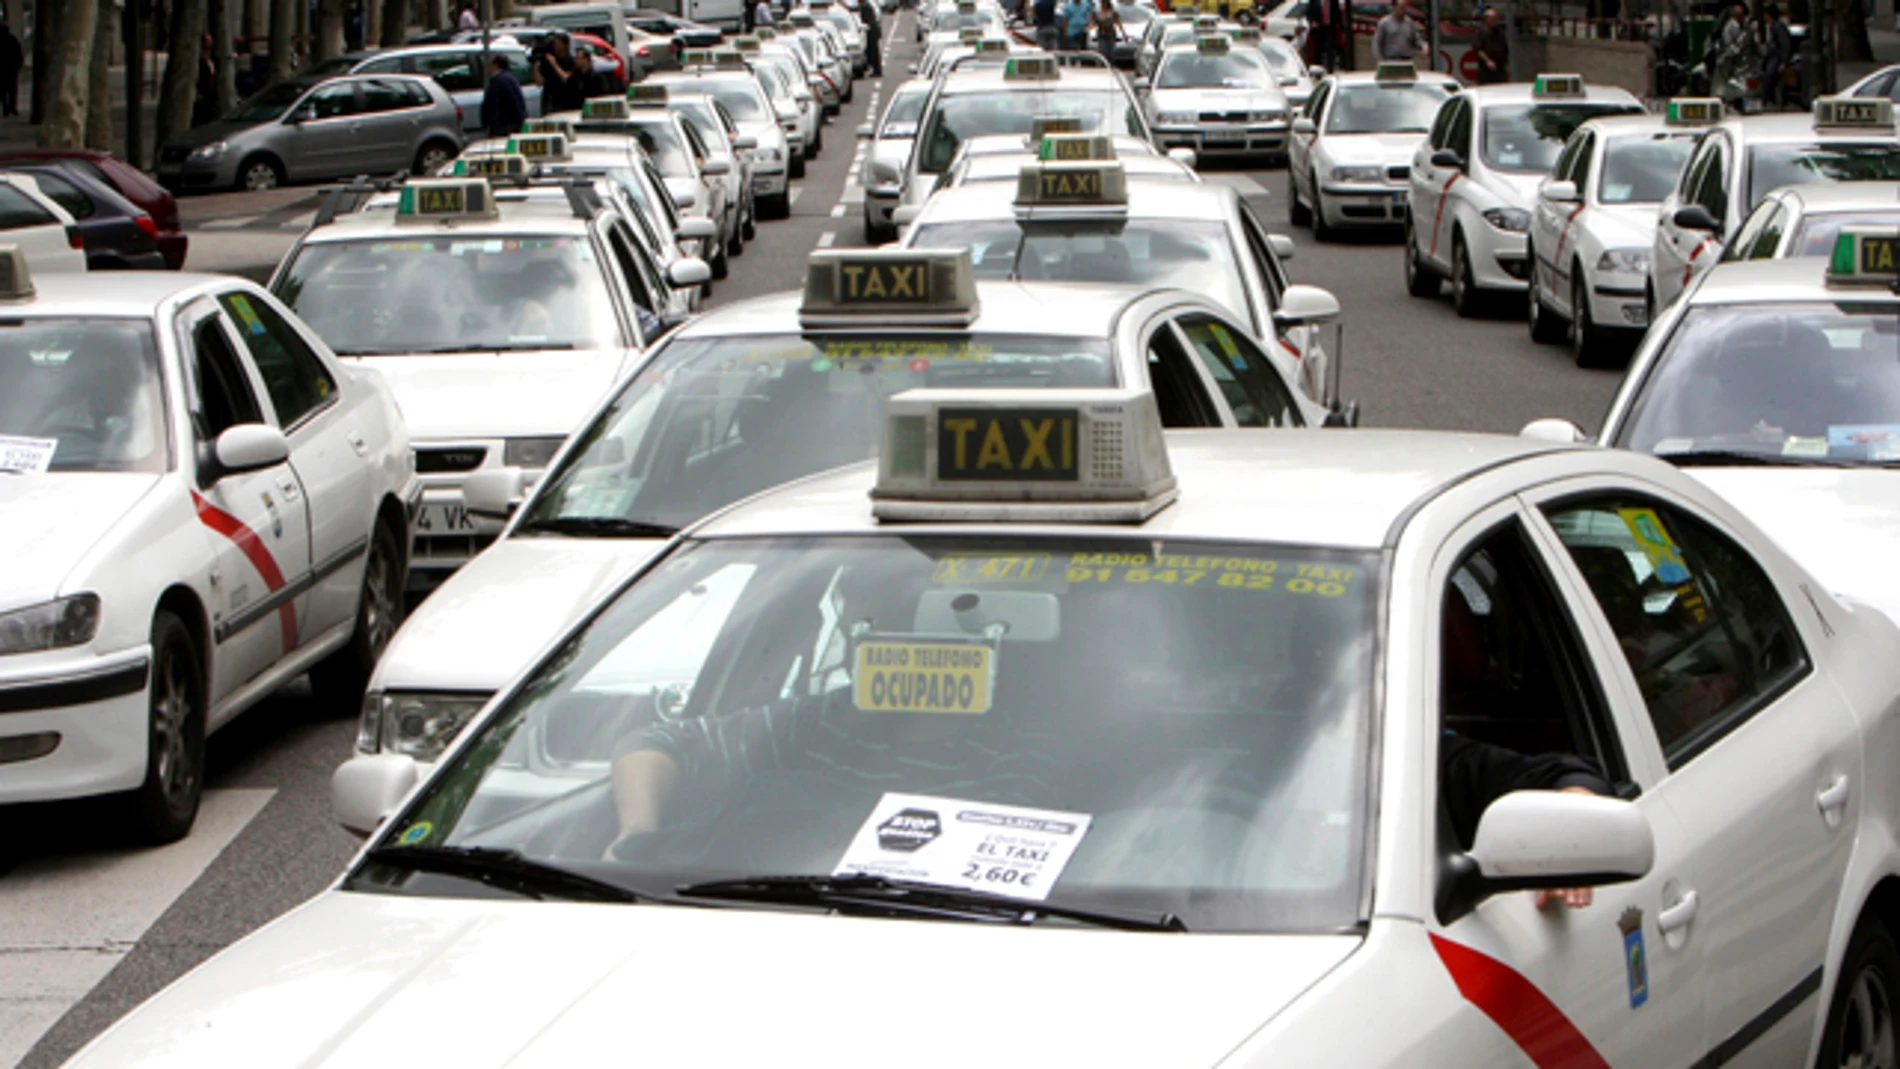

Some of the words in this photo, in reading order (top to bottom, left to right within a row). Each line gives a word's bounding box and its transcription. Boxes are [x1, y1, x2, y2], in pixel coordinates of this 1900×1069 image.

[1042, 174, 1098, 195] TAXI
[421, 190, 462, 210] TAXI
[843, 266, 926, 298] TAXI
[944, 418, 1073, 470] TAXI
[444, 506, 474, 530] VK
[1071, 552, 1148, 566] RADIO
[1155, 554, 1278, 574] TELEFONO
[1296, 563, 1354, 583] TAXI
[1065, 567, 1112, 583] 91
[1216, 572, 1275, 590] 82
[1286, 577, 1347, 598] 00
[866, 646, 910, 666] RADIO
[914, 647, 983, 669] TELEFONO
[871, 670, 974, 709] OCUPADO
[890, 815, 936, 830] STOP
[976, 842, 997, 856] EL
[1006, 845, 1050, 862] TAXI
